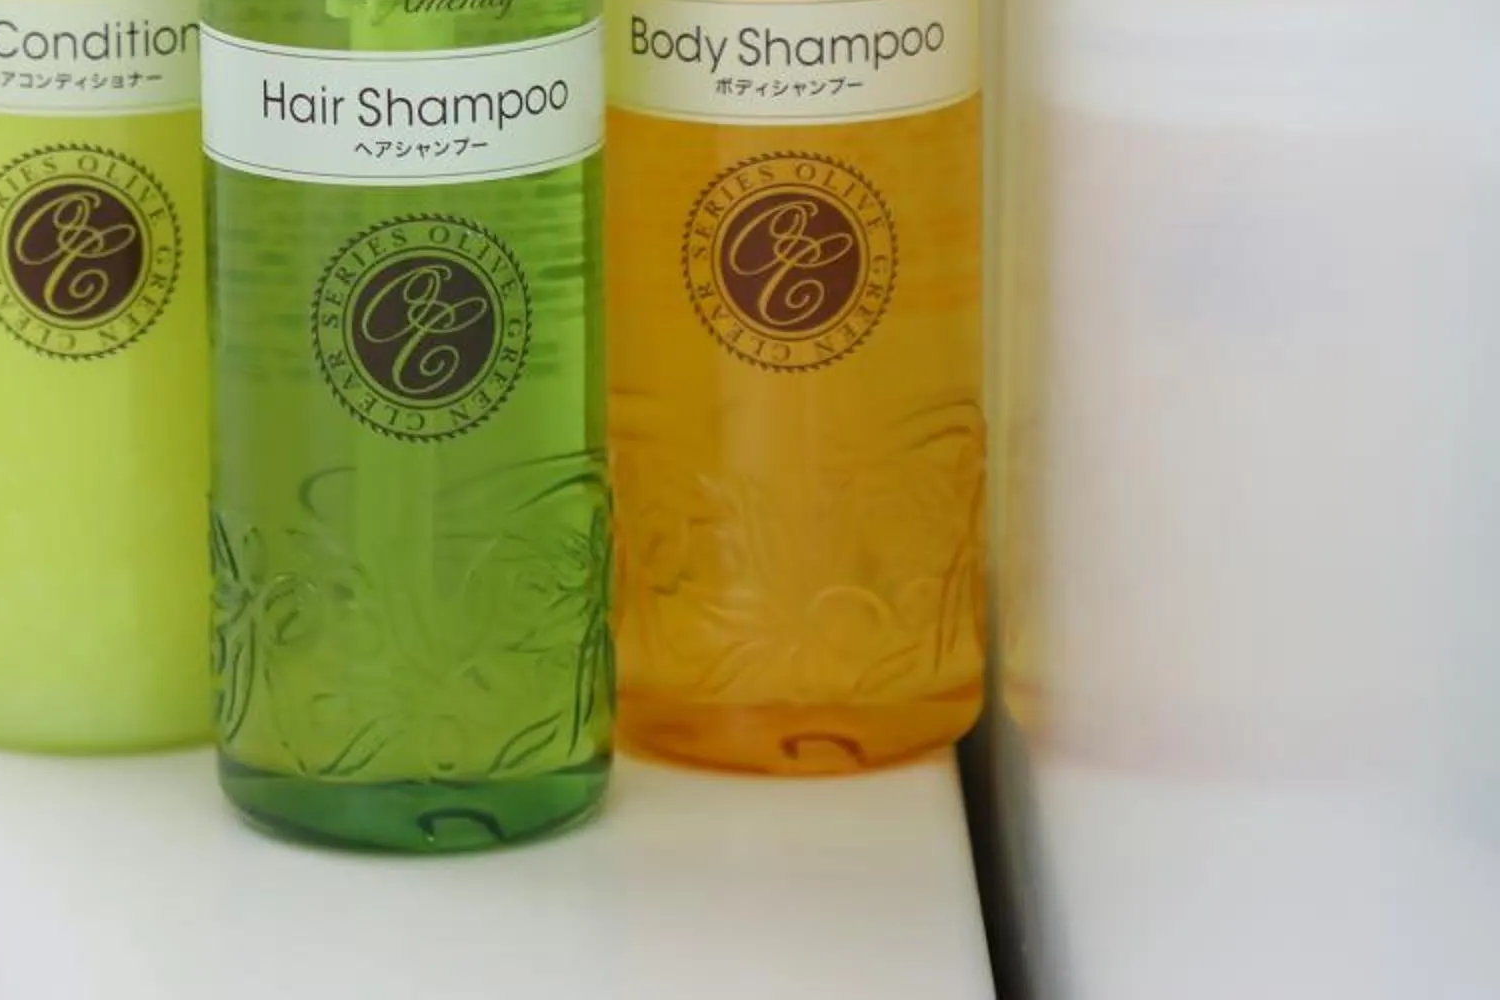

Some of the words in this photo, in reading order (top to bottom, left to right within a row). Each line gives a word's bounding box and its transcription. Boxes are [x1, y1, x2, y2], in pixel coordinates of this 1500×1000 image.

[631, 15, 727, 73] Body
[738, 21, 945, 71] Shampoo
[263, 78, 344, 126] Hair
[357, 79, 569, 130] Shampoo
[715, 77, 864, 97] ボディシャンプー
[354, 137, 489, 159] ヘアシャンプー
[692, 163, 775, 260] SERIES
[795, 162, 884, 229] OLIVE
[323, 226, 408, 330] SERIES
[428, 225, 517, 298] OLIVE
[327, 350, 425, 432] CLEAR
[449, 317, 522, 426] GREEN
